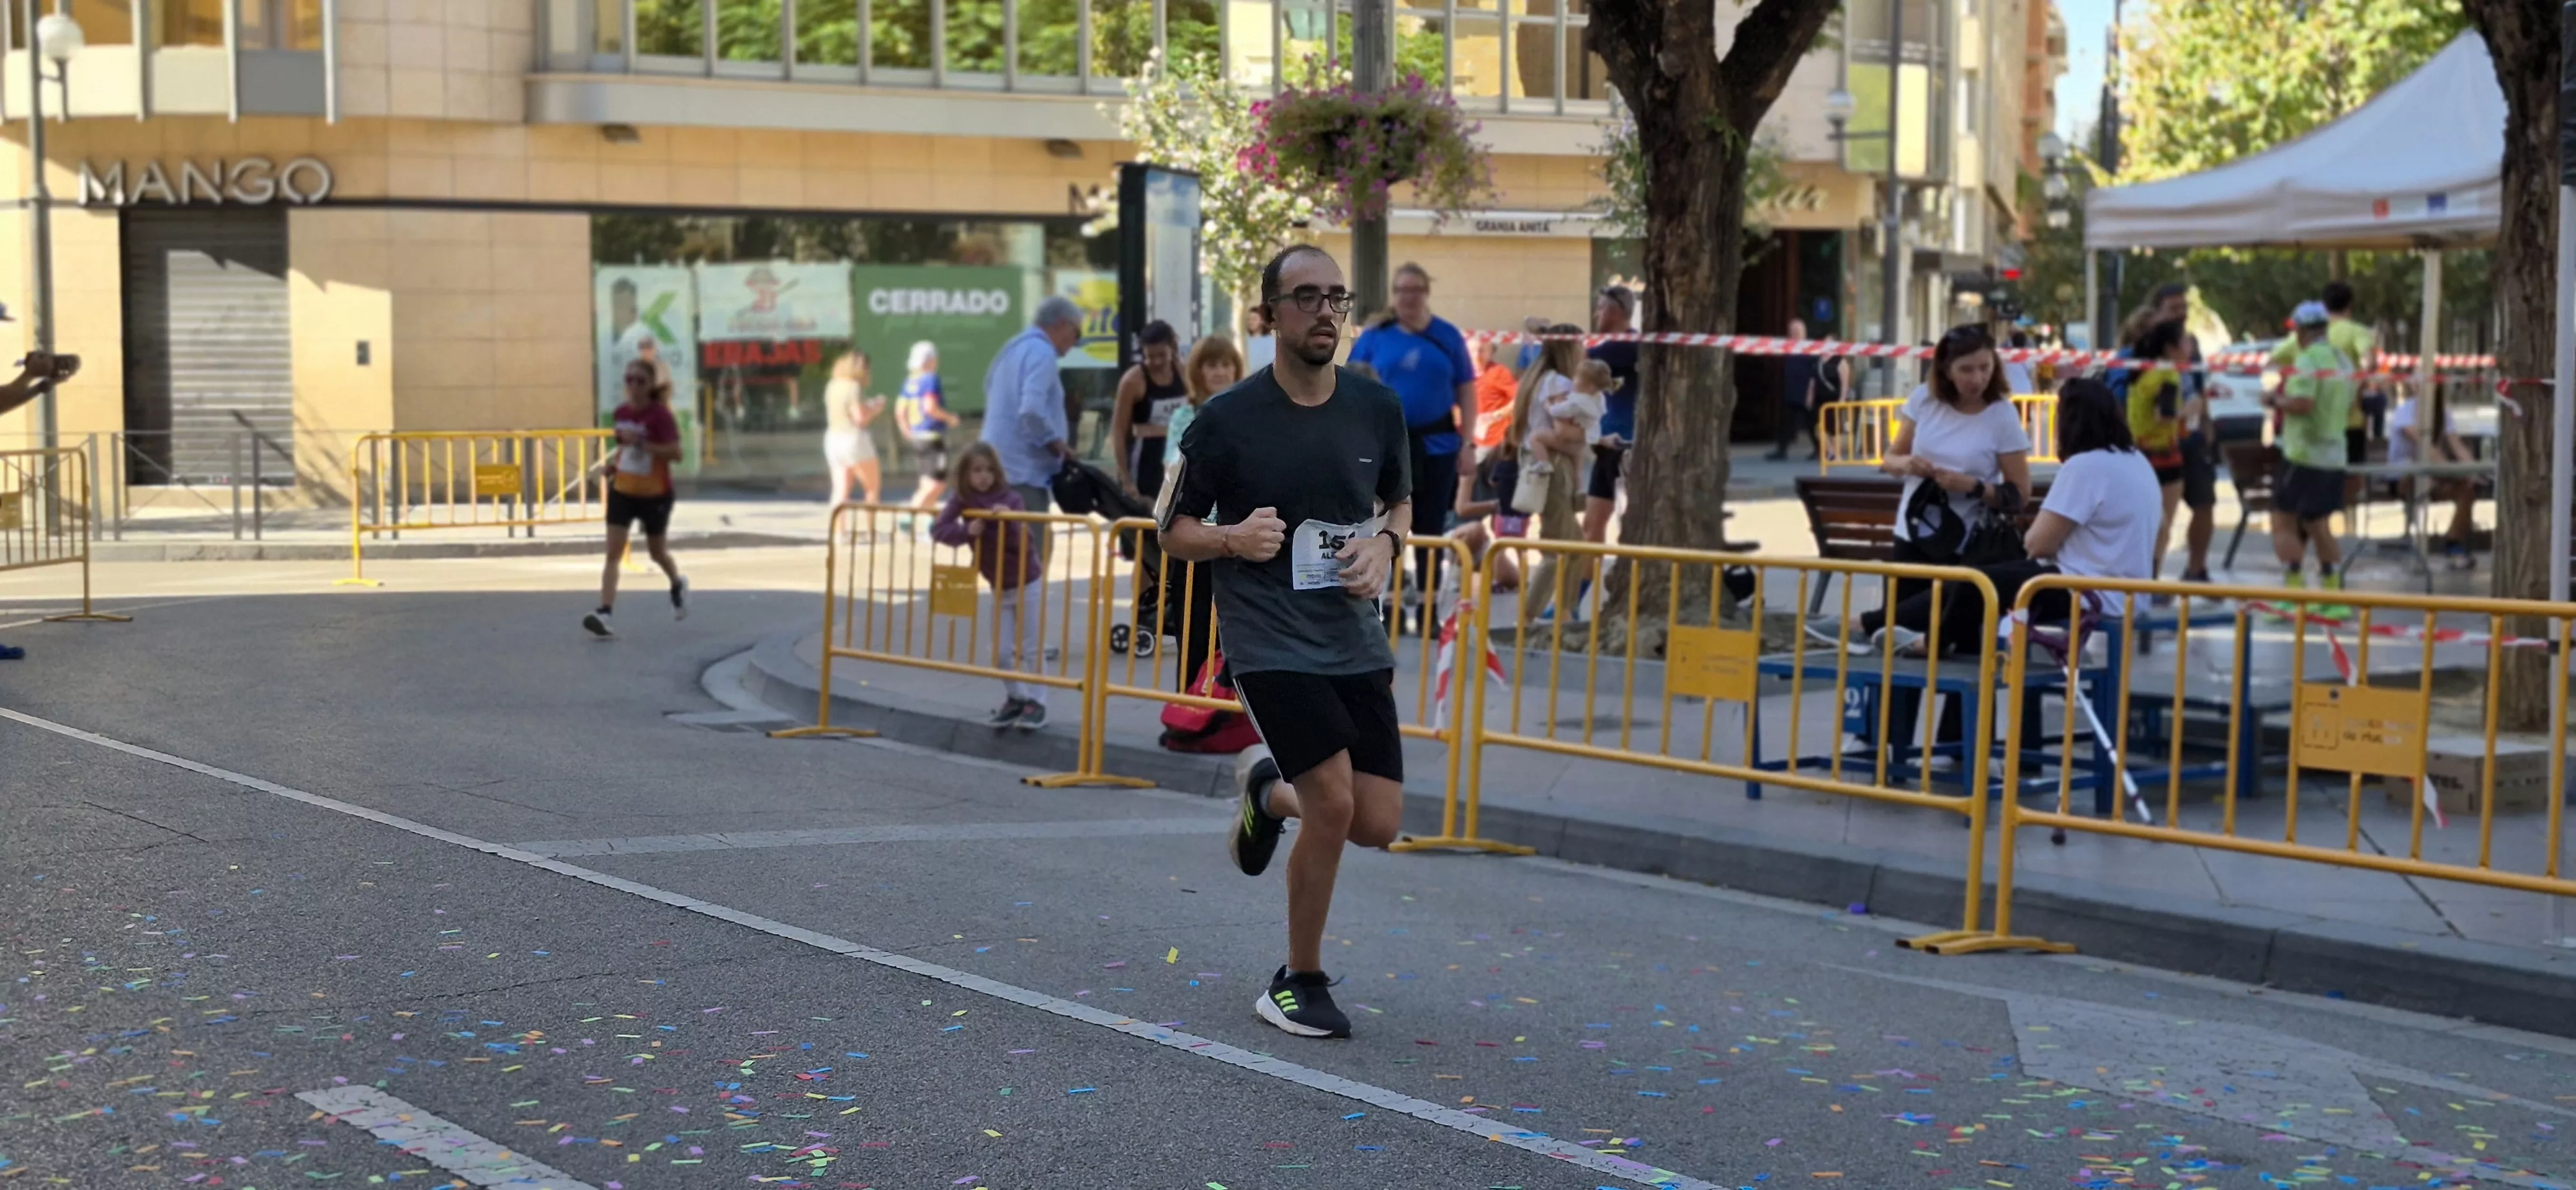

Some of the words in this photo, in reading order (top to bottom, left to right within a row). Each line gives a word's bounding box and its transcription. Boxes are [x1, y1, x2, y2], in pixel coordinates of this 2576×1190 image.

[78, 156, 333, 205] MANGO
[1475, 220, 1515, 232] GRANJA
[869, 288, 1010, 315] CERRADO
[1319, 530, 1356, 550] 15
